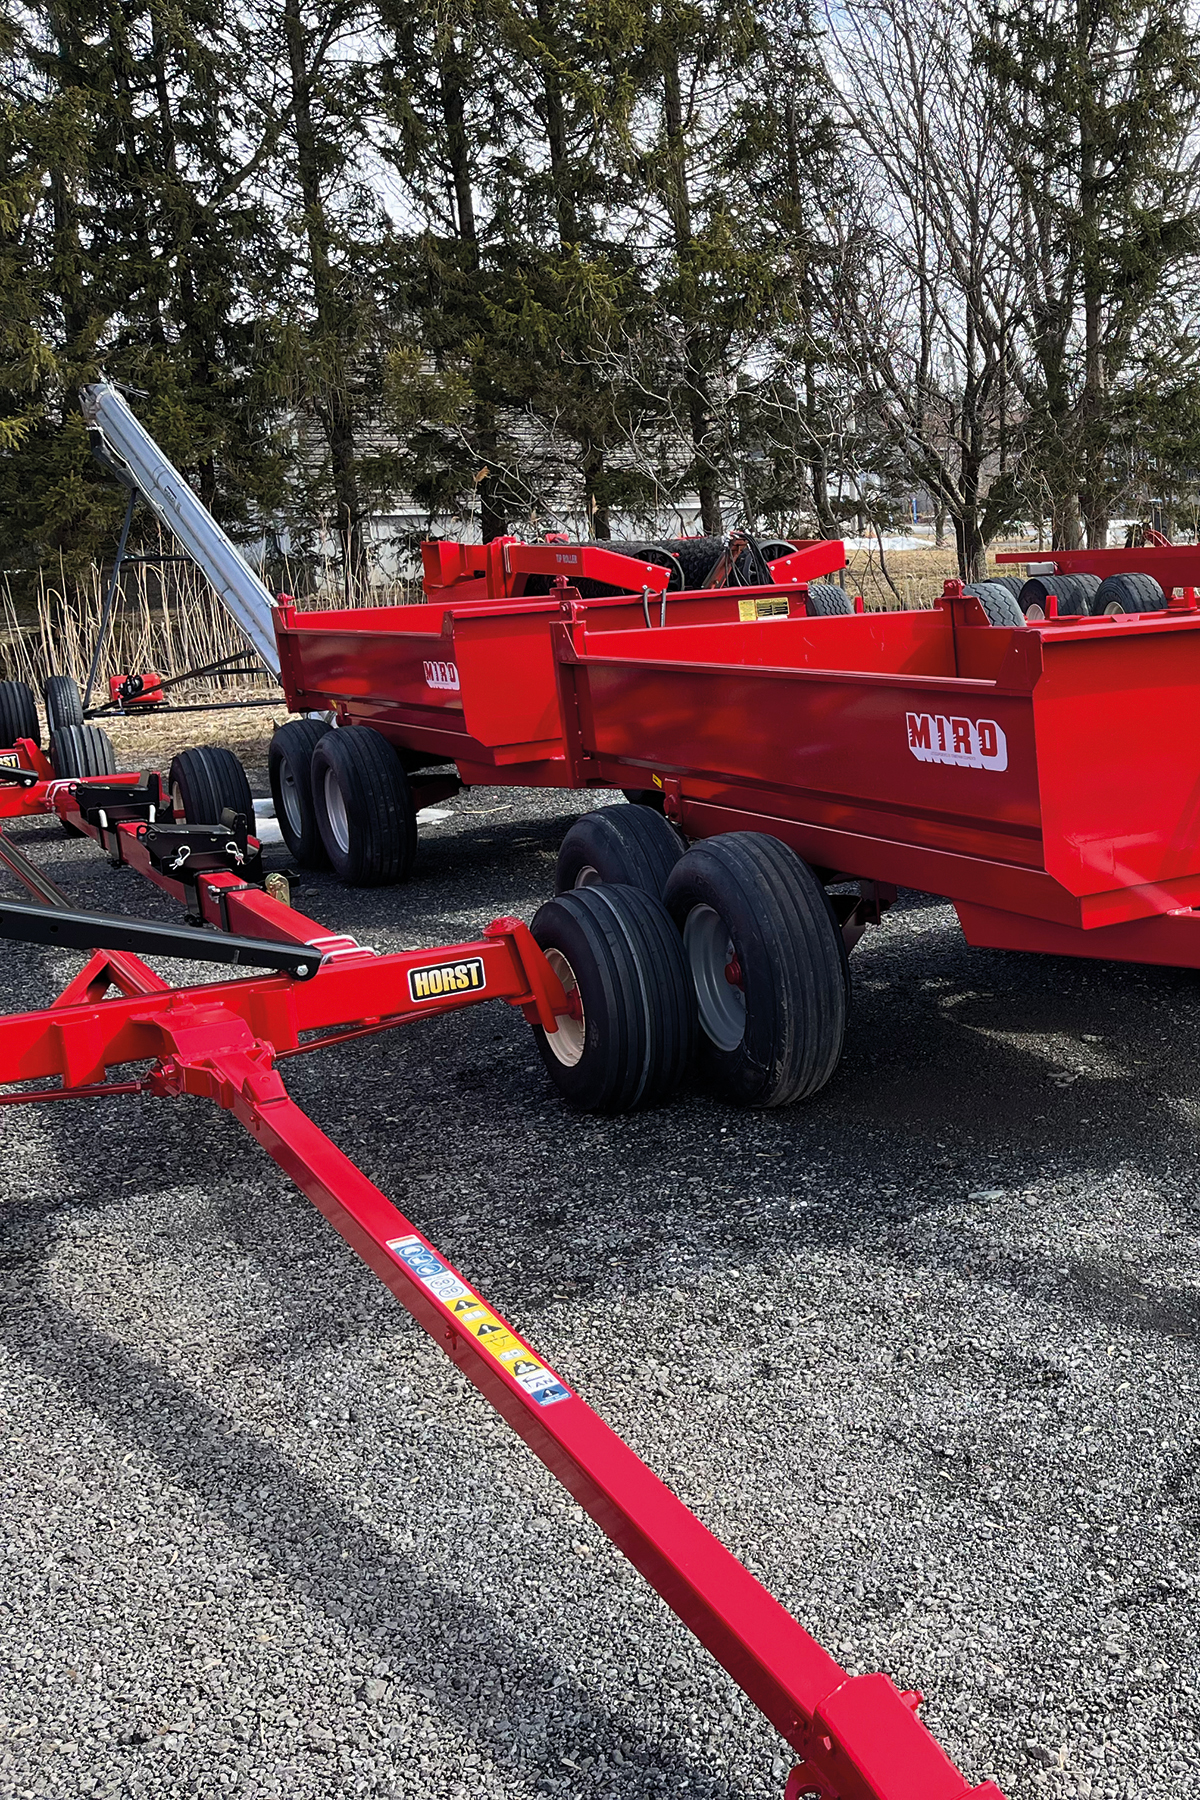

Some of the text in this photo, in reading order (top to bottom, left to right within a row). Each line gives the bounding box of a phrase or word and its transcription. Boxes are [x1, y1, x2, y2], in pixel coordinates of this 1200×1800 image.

[423, 661, 457, 684] MIRO
[906, 713, 1000, 759] MIRO
[414, 962, 480, 997] HORST
[435, 1279, 450, 1287] 50
[443, 1287, 459, 1295] 30
